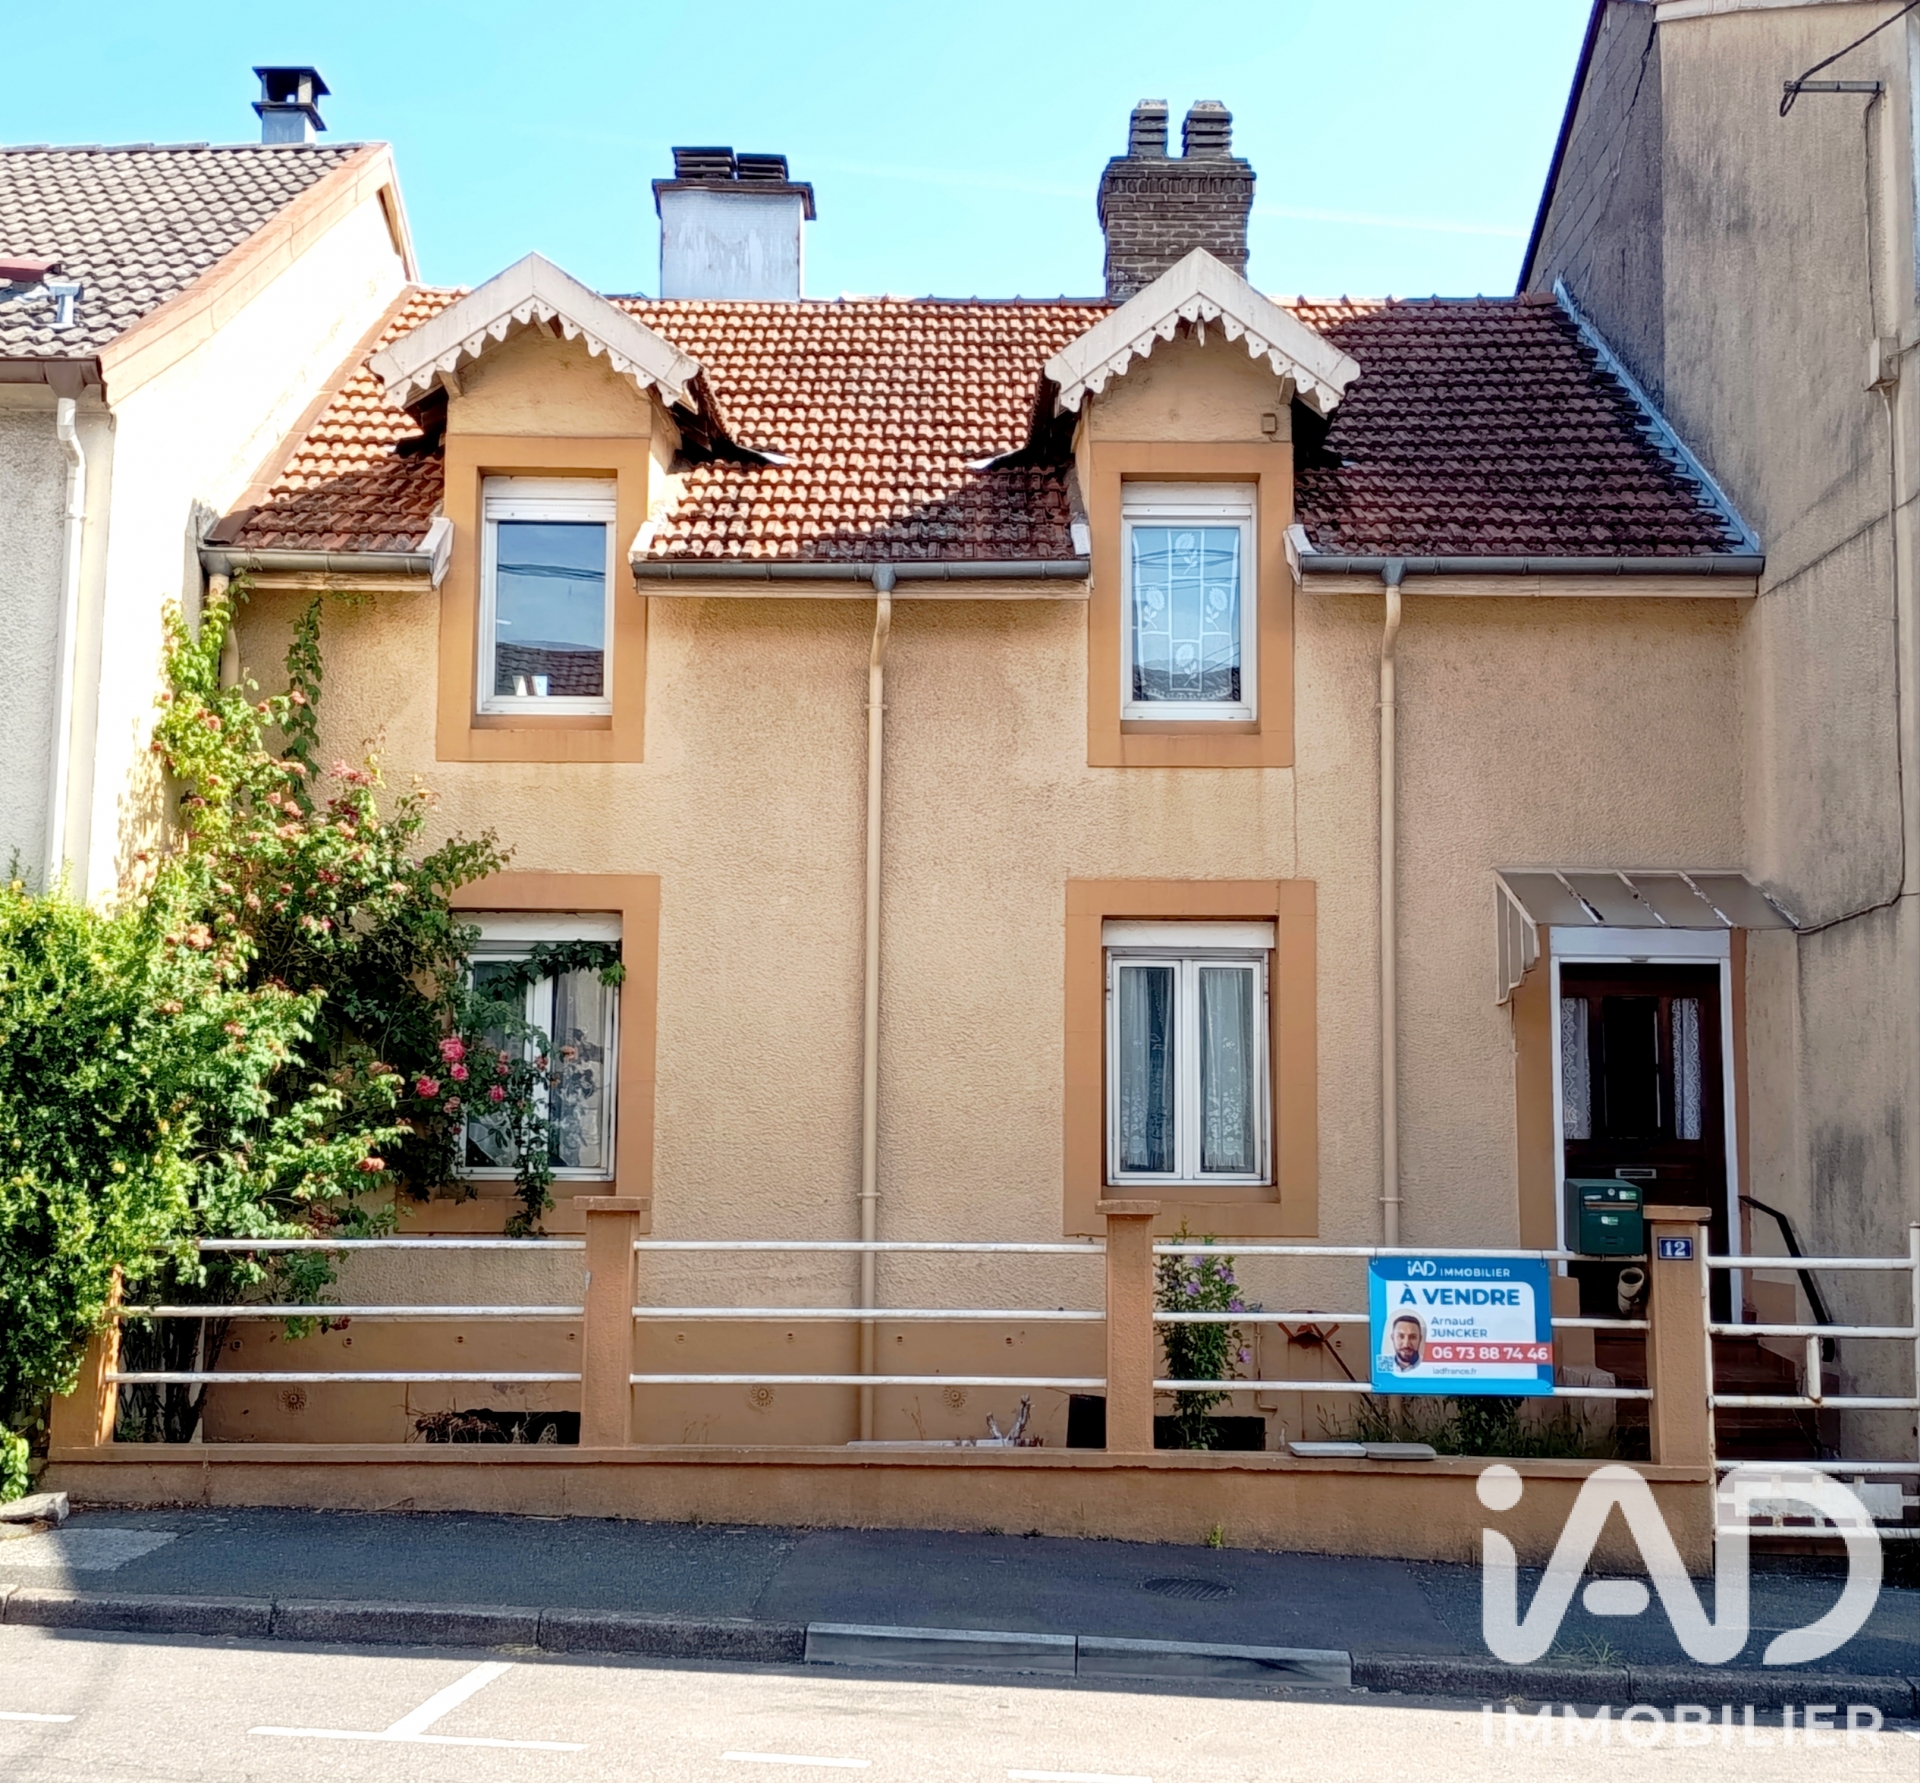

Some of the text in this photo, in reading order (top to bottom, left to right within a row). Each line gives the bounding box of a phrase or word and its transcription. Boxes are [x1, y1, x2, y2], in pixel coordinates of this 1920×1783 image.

[1665, 1241, 1686, 1256] 12
[1440, 1268, 1511, 1277] IMMOBILIER
[1399, 1283, 1521, 1306] À VENDRE
[1430, 1316, 1474, 1326] Arnaud
[1430, 1328, 1488, 1338] JUNCKER
[1432, 1346, 1549, 1360] 06 73 88 74 46
[1432, 1367, 1477, 1376] iadfrance.fr
